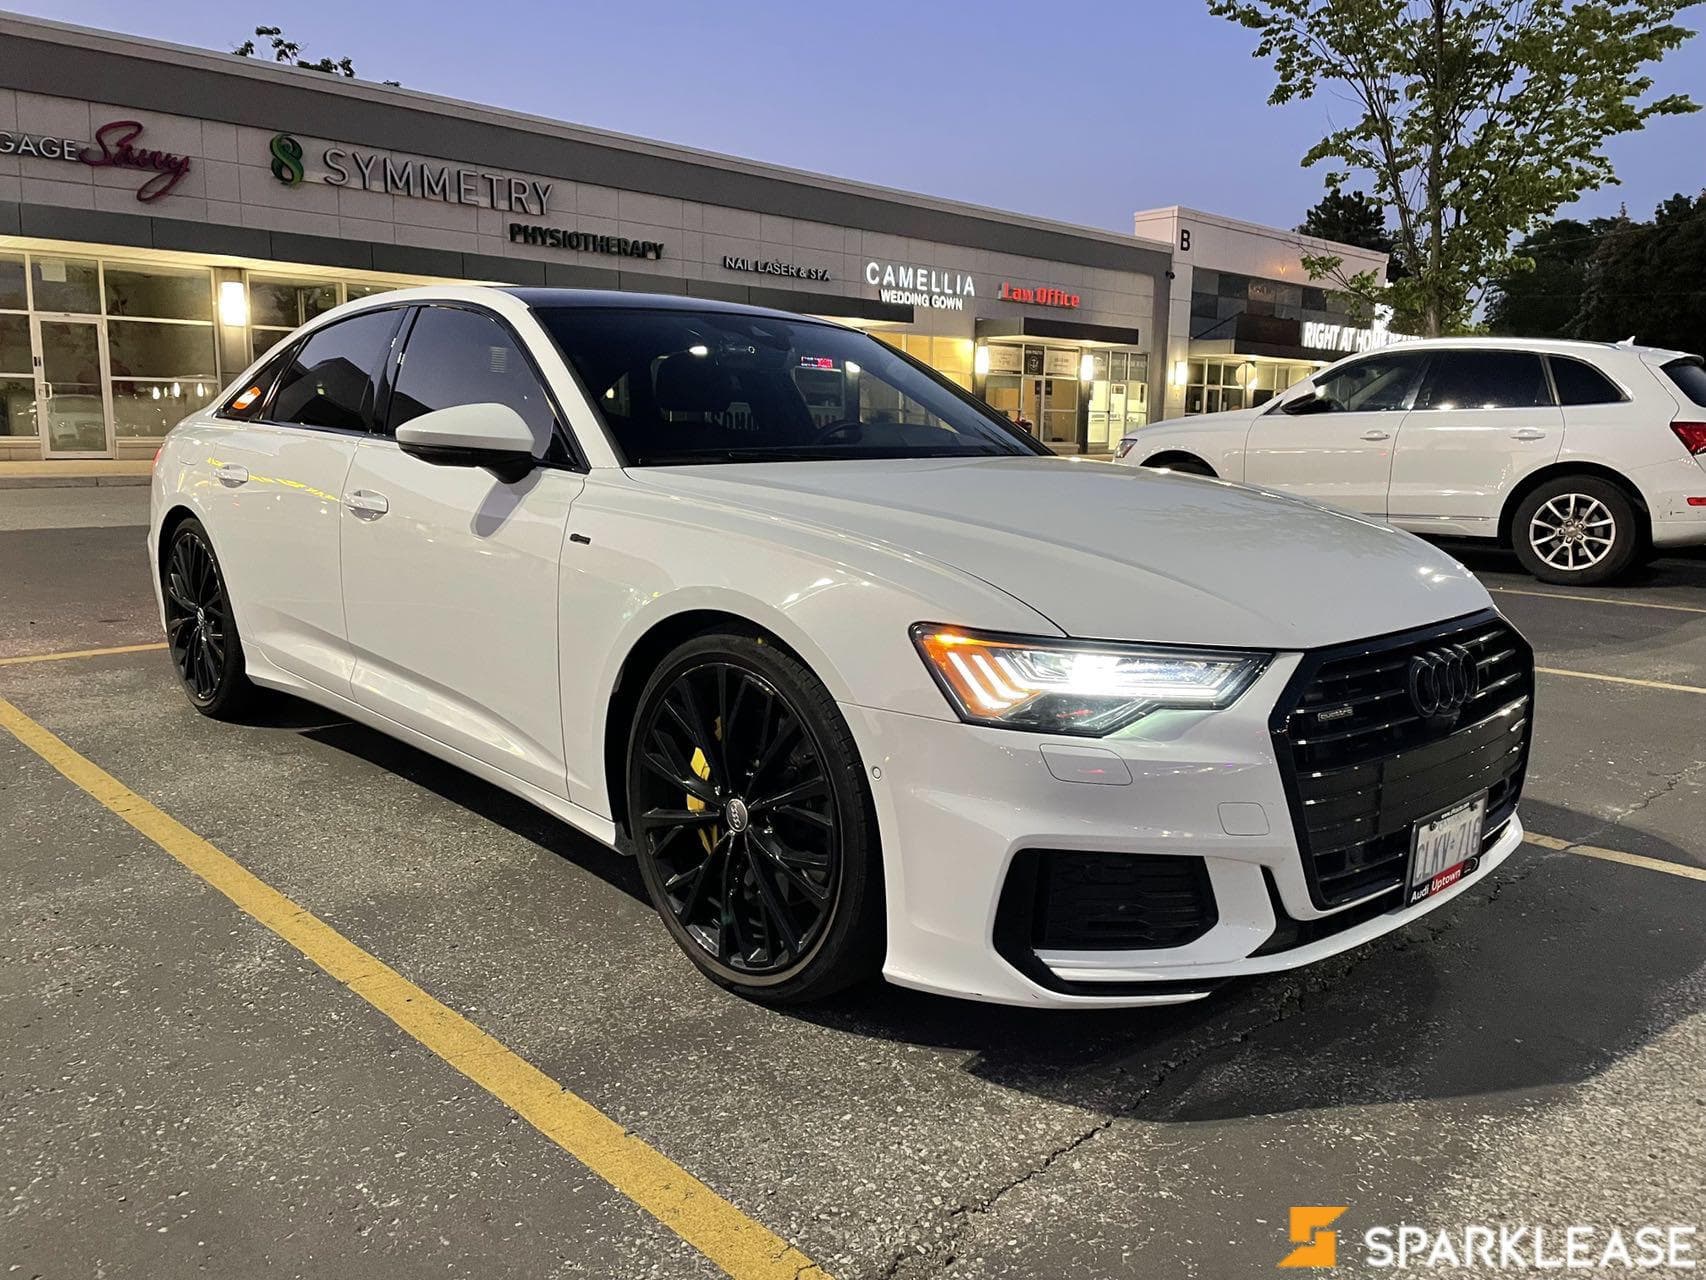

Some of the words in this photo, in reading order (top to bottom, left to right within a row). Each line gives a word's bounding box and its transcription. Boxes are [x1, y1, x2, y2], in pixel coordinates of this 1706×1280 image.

[323, 148, 553, 215] SYMMETRY
[509, 223, 664, 260] PHYSIOTHERAPY
[1180, 229, 1190, 251] B
[724, 256, 753, 271] NAIL
[756, 260, 797, 277] LASER
[799, 266, 807, 278] &
[809, 267, 832, 281] SPA
[866, 262, 975, 297] CAMELLIA
[880, 289, 929, 307] WEDDING
[931, 295, 963, 311] GOWN
[1001, 282, 1034, 302] Law
[1036, 287, 1080, 307] Office
[1303, 321, 1341, 351] RIGHT
[1340, 327, 1356, 352] AT
[1411, 884, 1430, 903] Audi
[1431, 869, 1462, 891] Uptown
